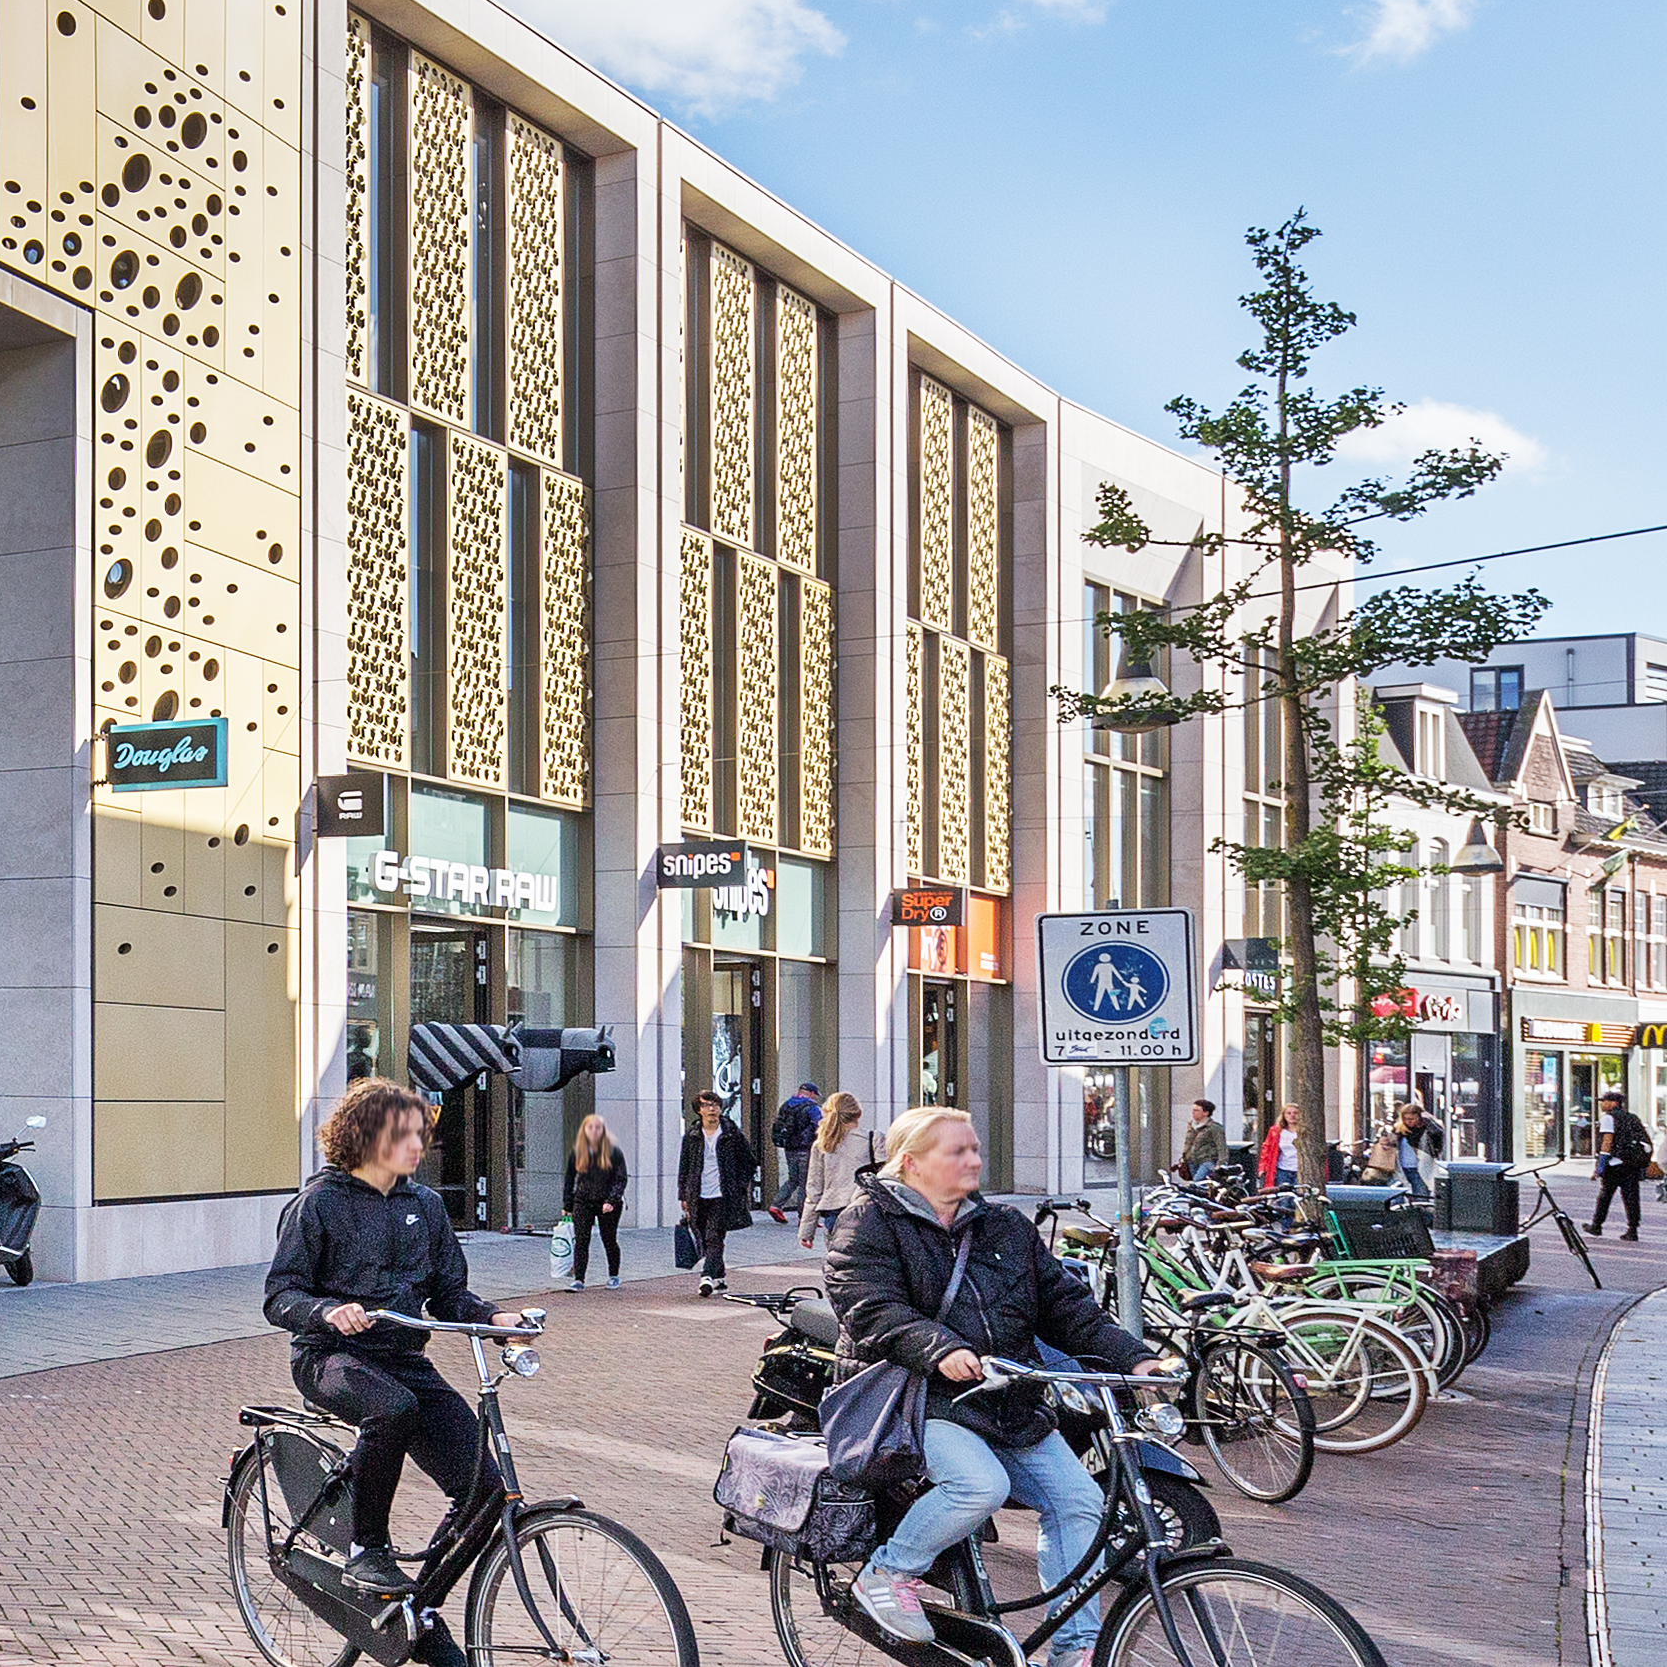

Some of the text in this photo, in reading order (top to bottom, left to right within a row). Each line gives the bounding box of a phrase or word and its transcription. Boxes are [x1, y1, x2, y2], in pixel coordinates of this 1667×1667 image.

[113, 735, 209, 773] Douglas
[338, 811, 363, 820] RAW
[663, 852, 732, 880] snipes
[371, 850, 558, 912] G-STAR RAW
[901, 893, 954, 909] Super
[1080, 920, 1150, 936] ZONE
[1120, 1045, 1164, 1056] 11.00
[1172, 1045, 1181, 1056] h
